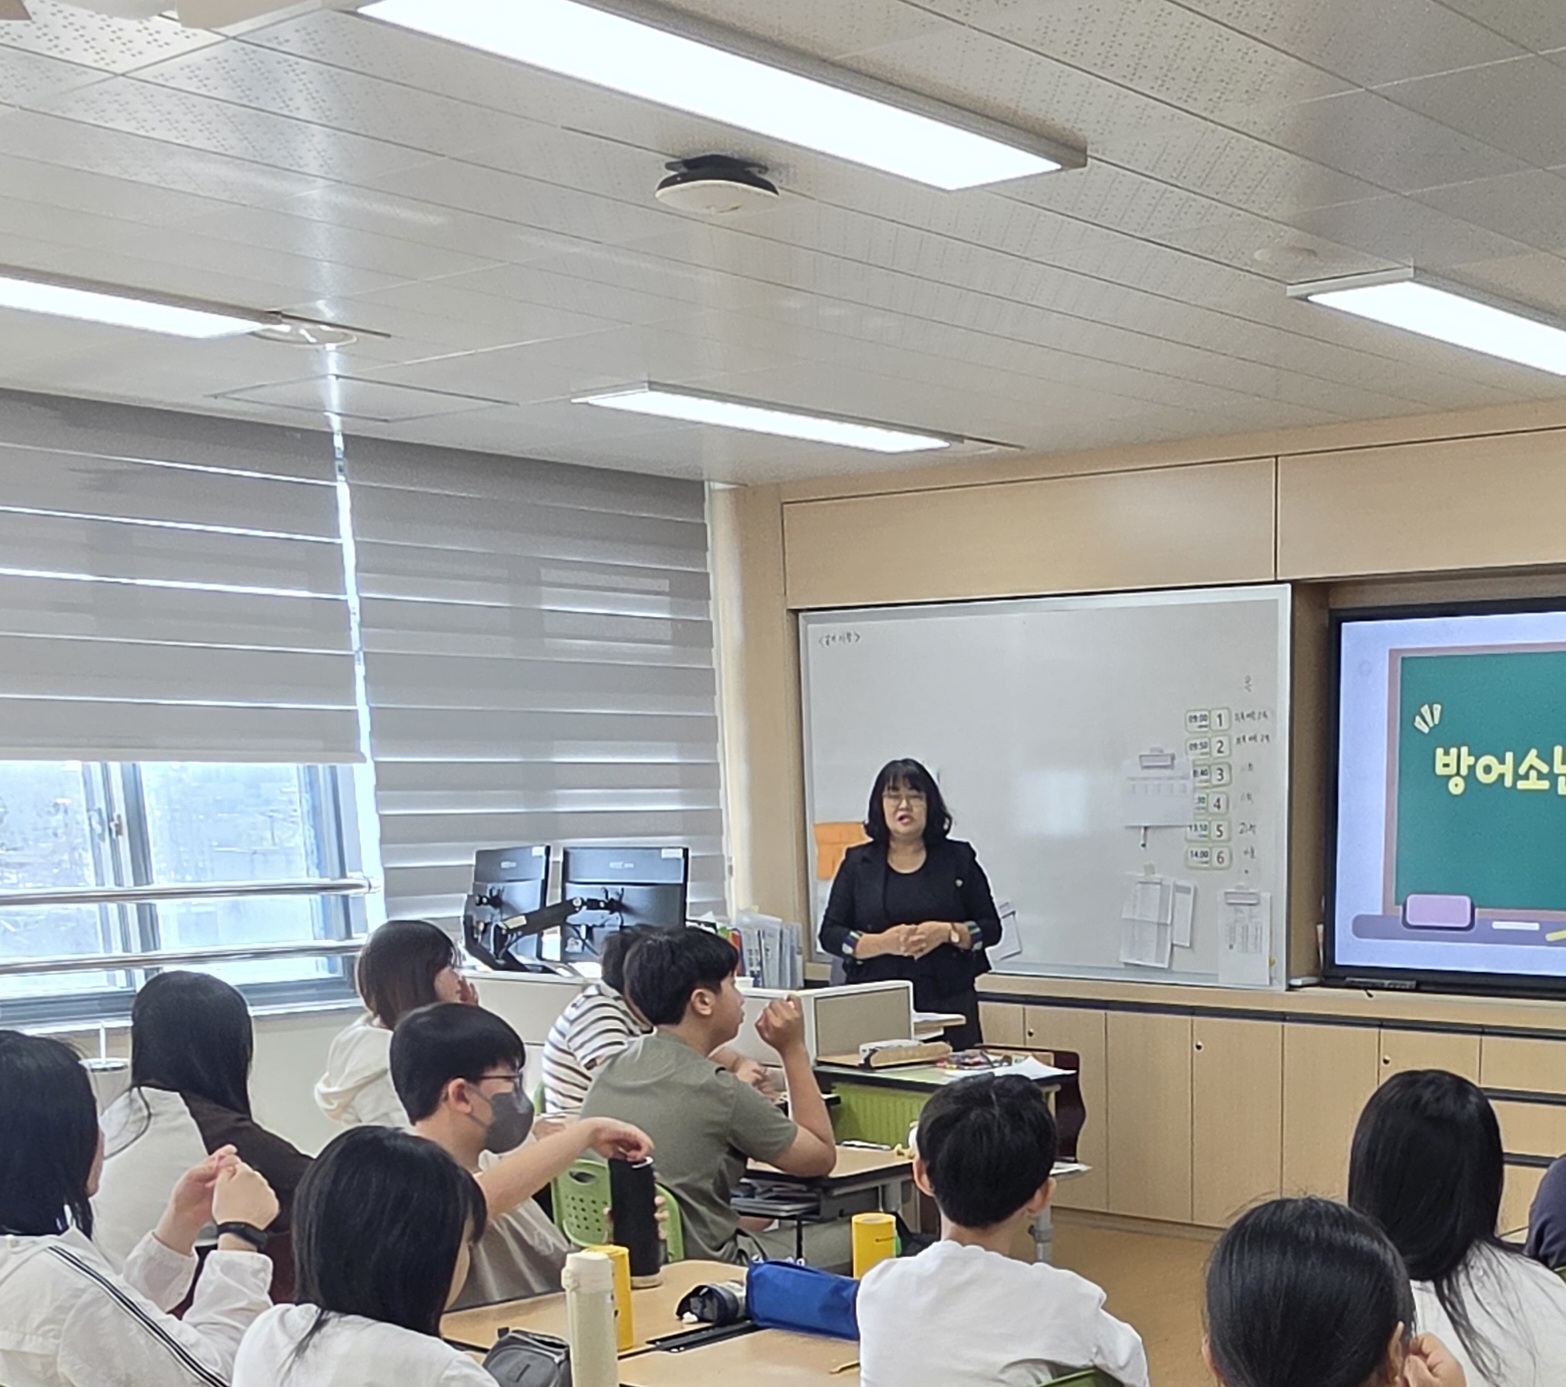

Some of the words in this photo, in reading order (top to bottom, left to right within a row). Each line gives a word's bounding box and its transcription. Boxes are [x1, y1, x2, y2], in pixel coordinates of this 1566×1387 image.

[1216, 712, 1222, 727] 1
[1216, 739, 1224, 754] 2
[1216, 767, 1224, 782] 3
[1213, 796, 1221, 811] 4
[1216, 823, 1224, 838] 5
[1216, 850, 1225, 865] 6
